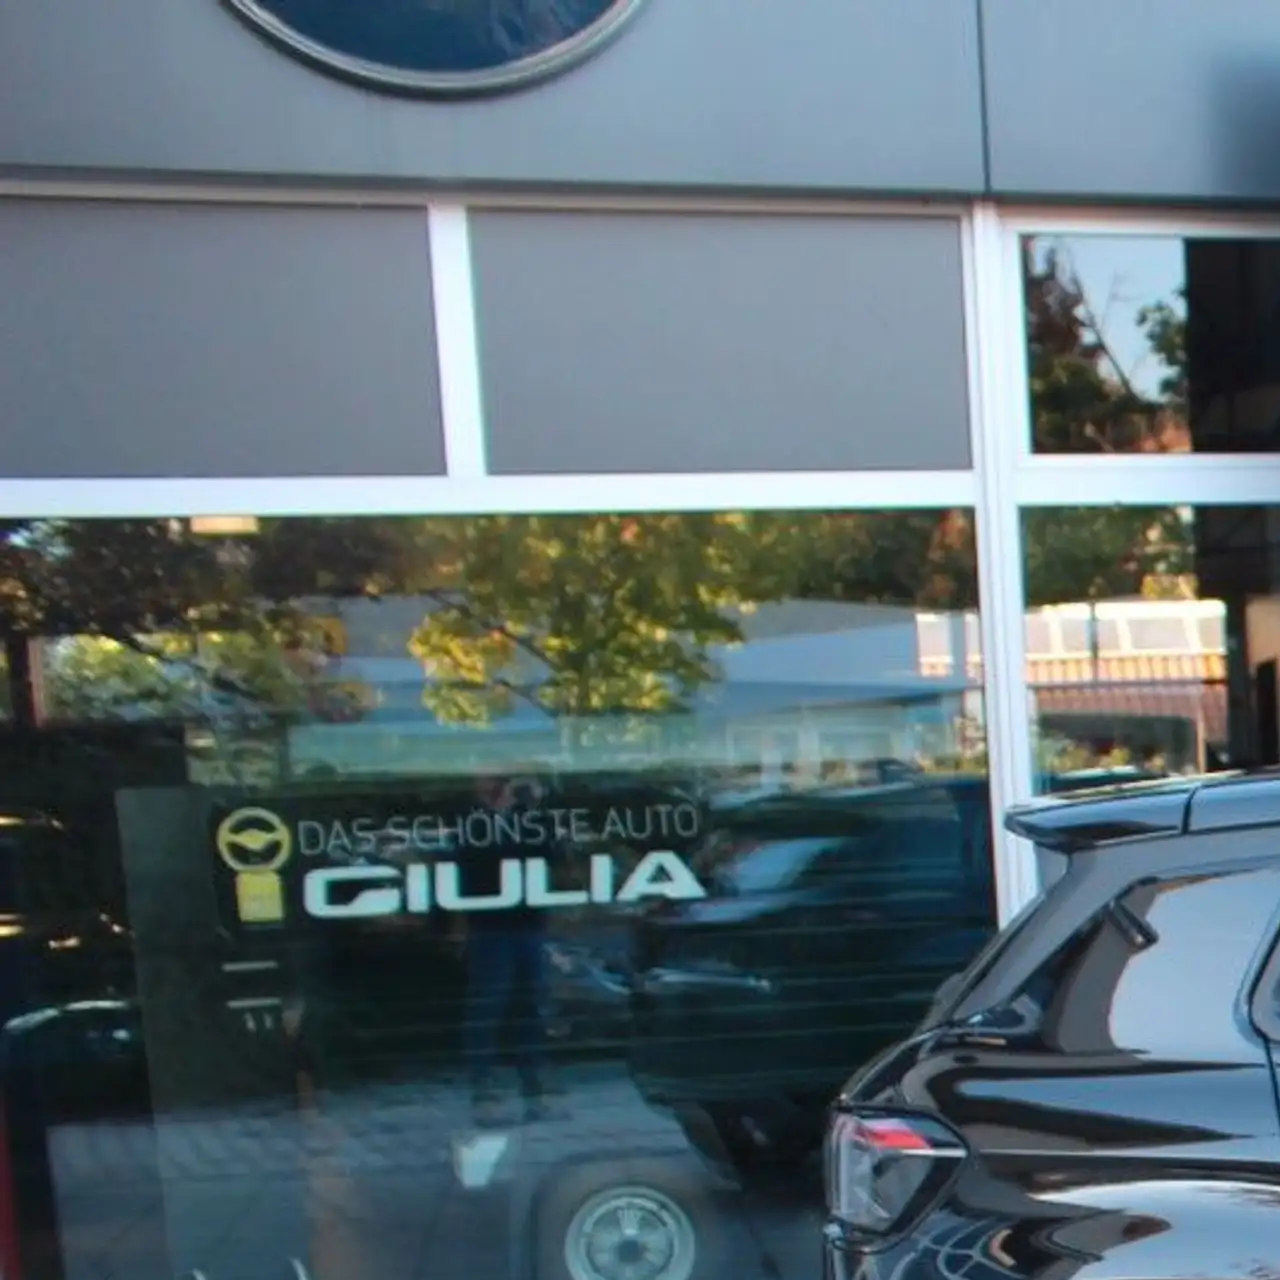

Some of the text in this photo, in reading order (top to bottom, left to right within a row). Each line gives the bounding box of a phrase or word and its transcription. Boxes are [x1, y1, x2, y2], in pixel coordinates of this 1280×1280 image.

[298, 803, 700, 857] DAS SCHÖNSTE AUTO
[303, 850, 707, 919] GIULIA
